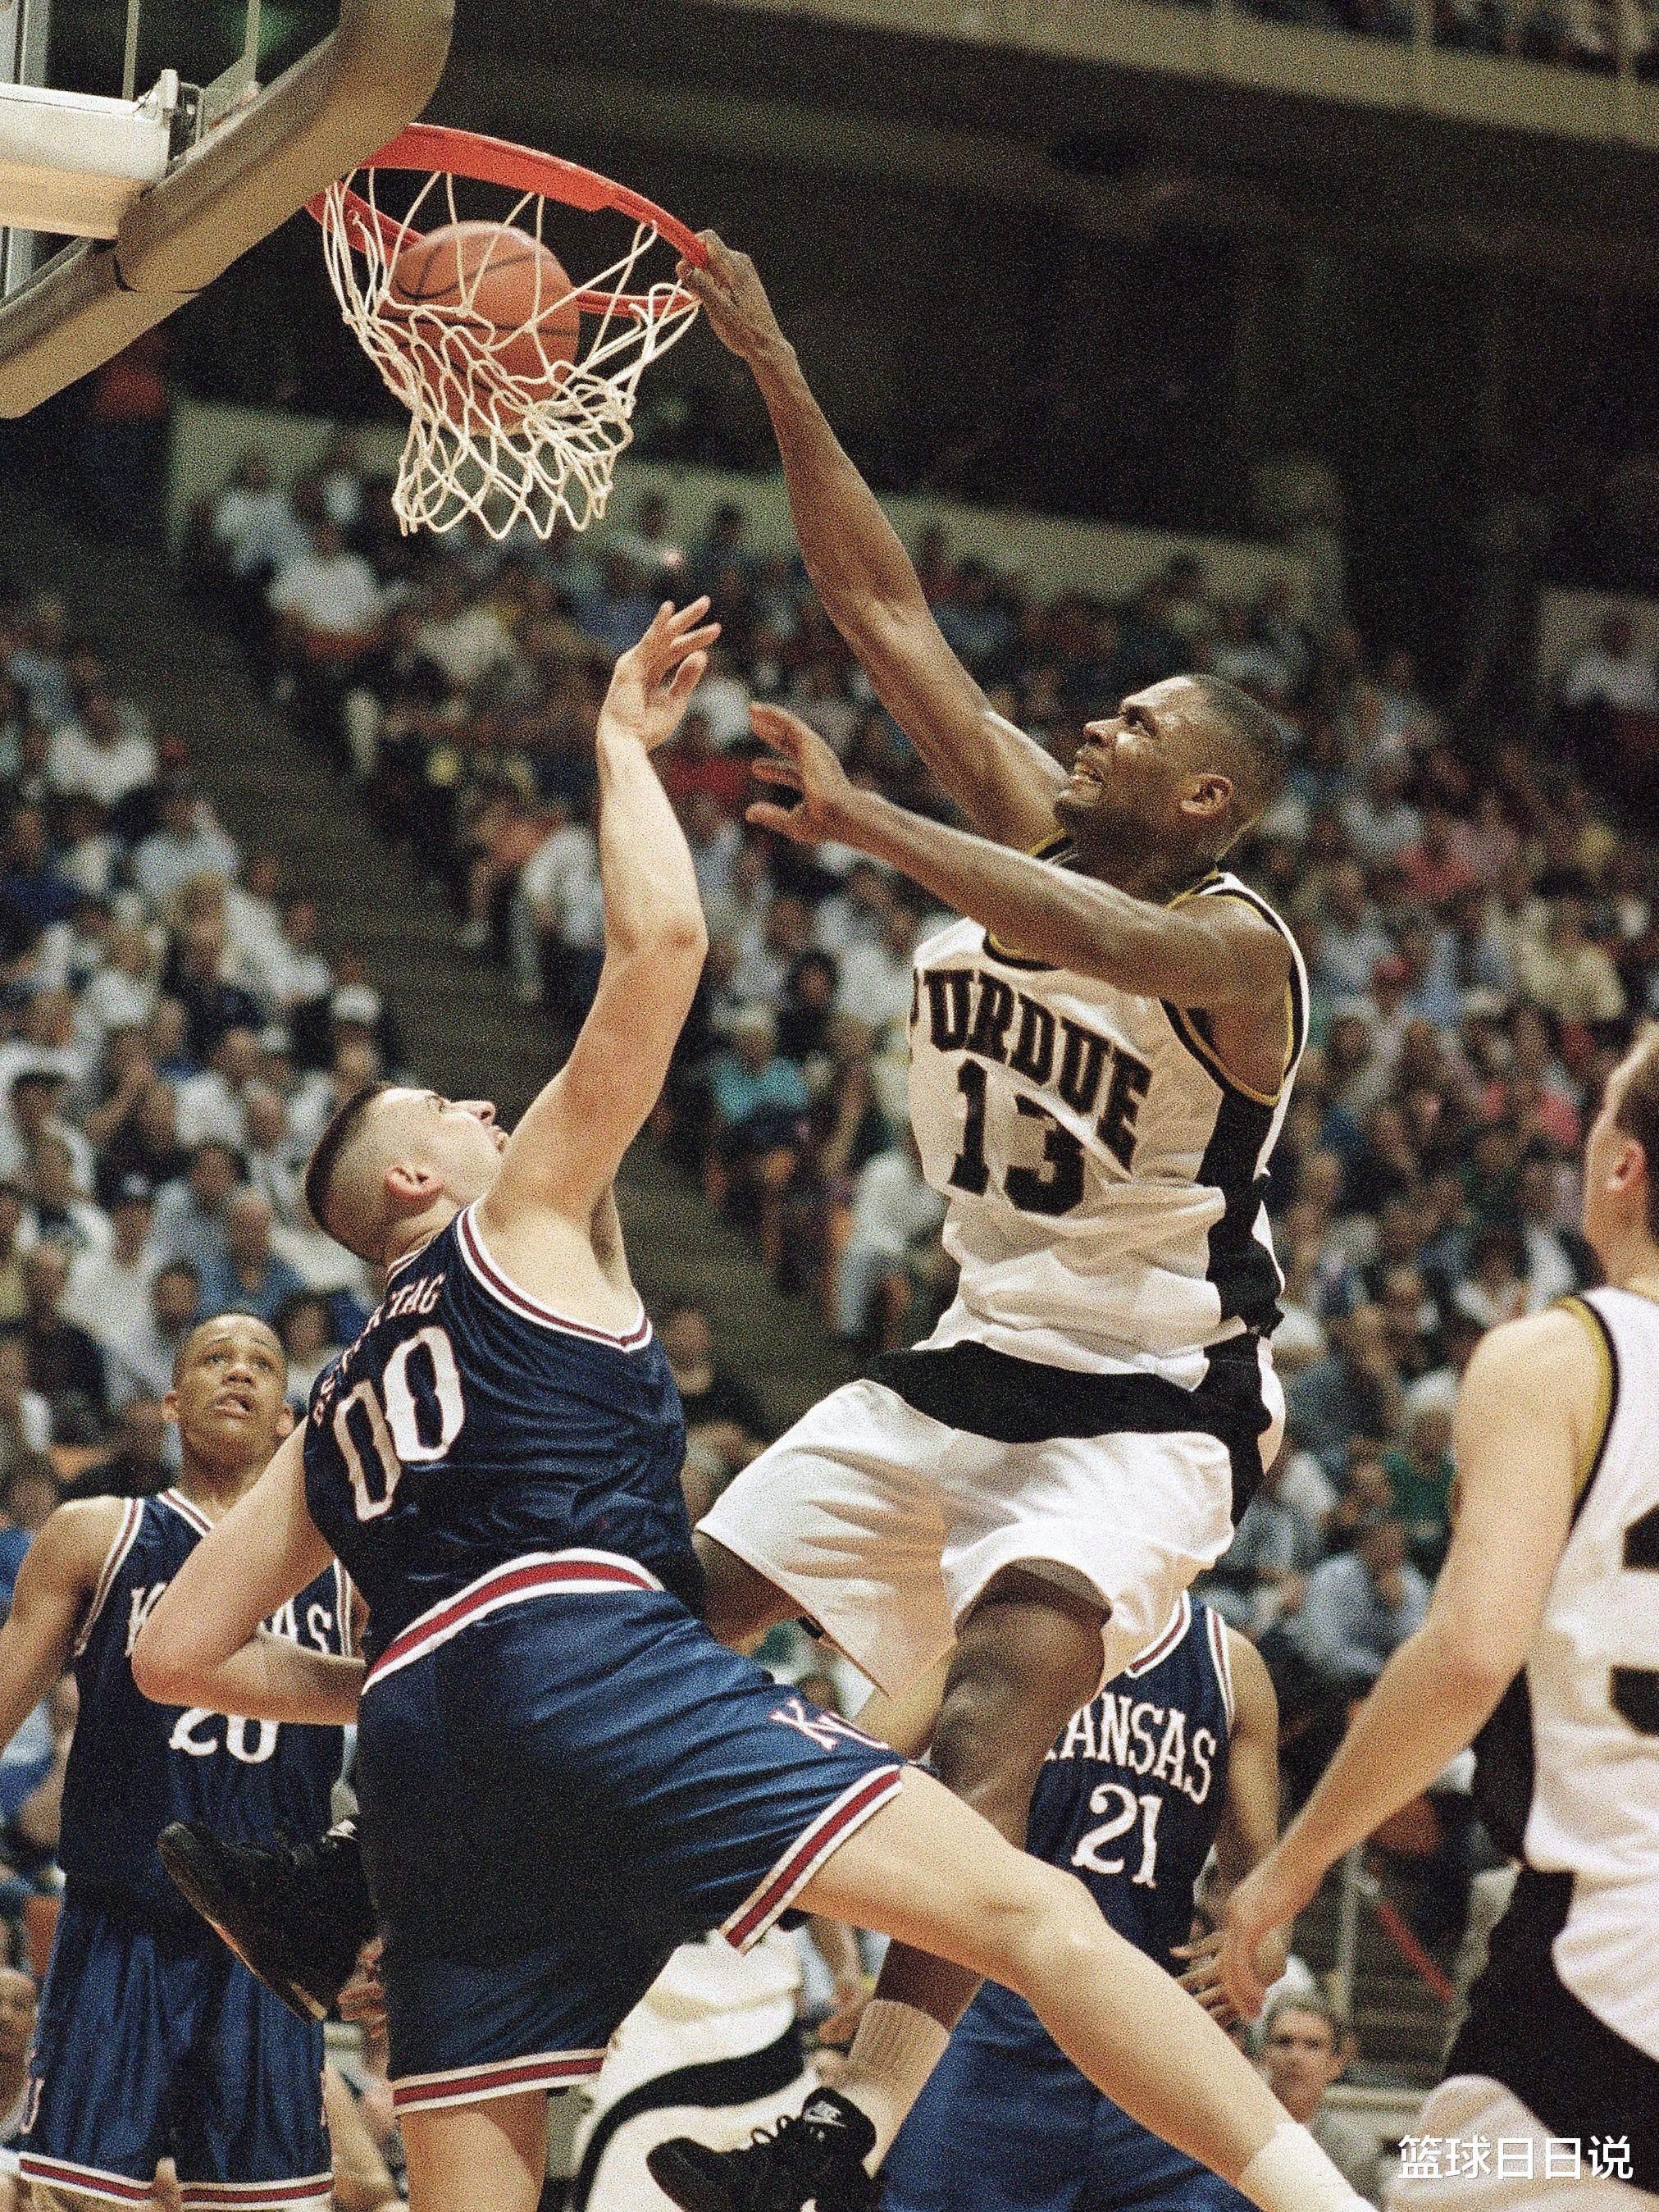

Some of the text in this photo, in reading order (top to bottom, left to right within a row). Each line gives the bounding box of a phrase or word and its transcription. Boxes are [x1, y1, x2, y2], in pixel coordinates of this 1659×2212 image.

[910, 968, 1151, 1173] URDUE
[949, 1058, 1085, 1215] 13
[333, 1325, 466, 1521] 00
[169, 1707, 280, 1763] 20
[1046, 1692, 1216, 1804] ANSAS
[1071, 1782, 1163, 1887] 21
